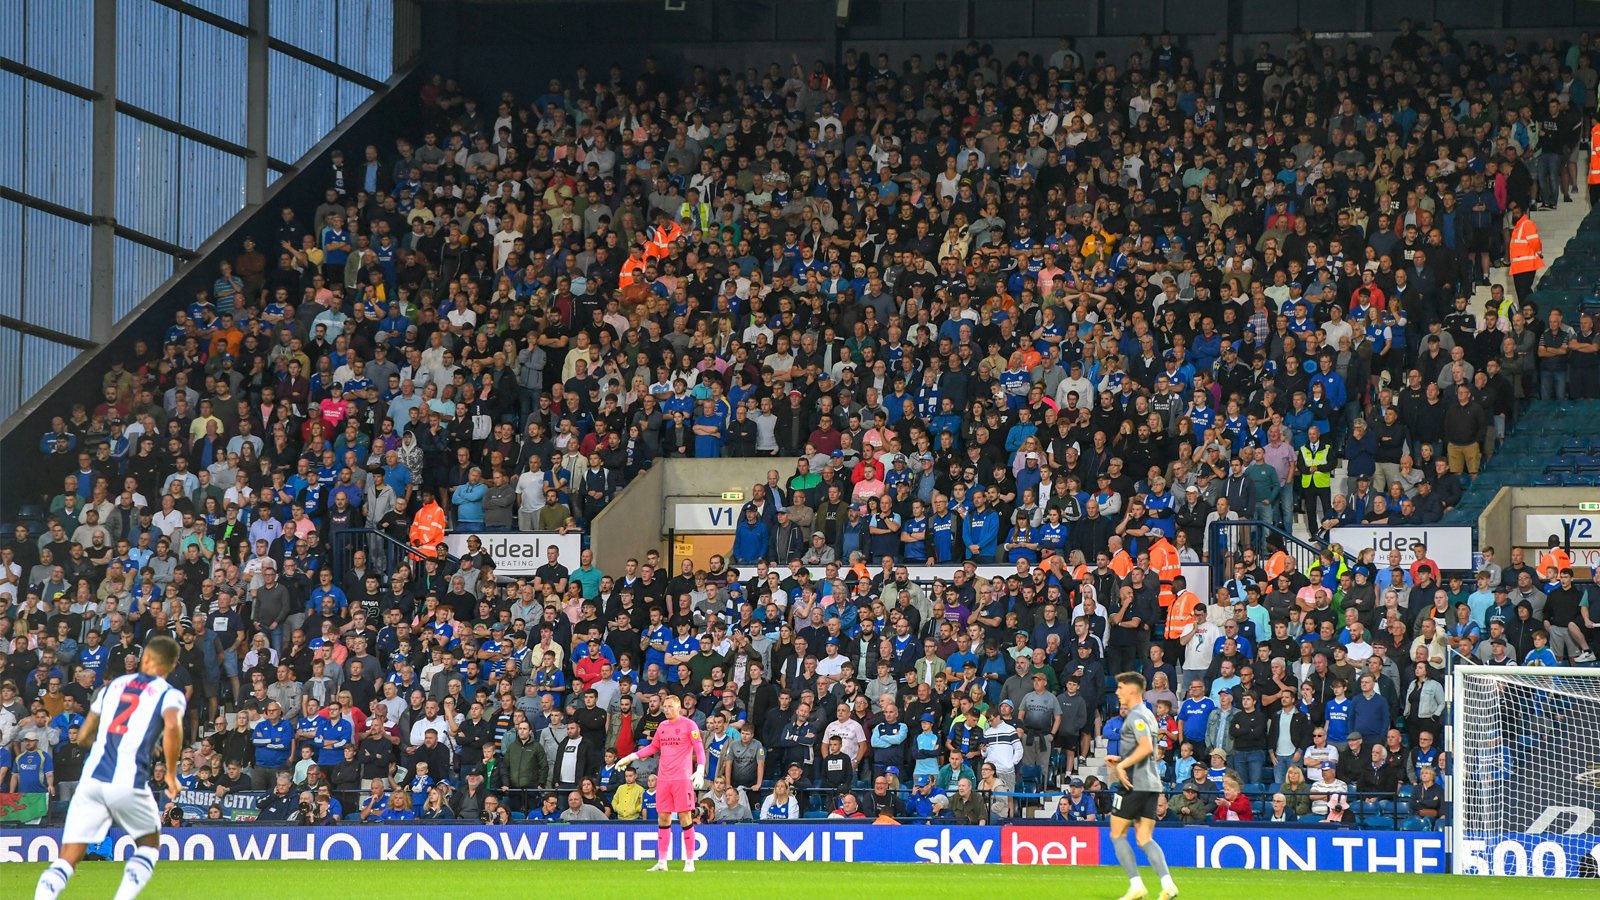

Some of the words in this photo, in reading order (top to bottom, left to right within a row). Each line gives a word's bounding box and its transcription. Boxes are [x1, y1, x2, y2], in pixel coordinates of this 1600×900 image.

[708, 507, 733, 526] V1
[1561, 518, 1593, 538] V2
[490, 538, 540, 558] ideal
[1373, 531, 1428, 551] ideal
[108, 692, 140, 735] 2
[224, 793, 255, 810] CITY
[227, 832, 362, 861] WHO
[380, 832, 549, 861] KNOW
[914, 828, 994, 865] sky
[1011, 831, 1088, 866] bet
[1332, 837, 1442, 873] THE
